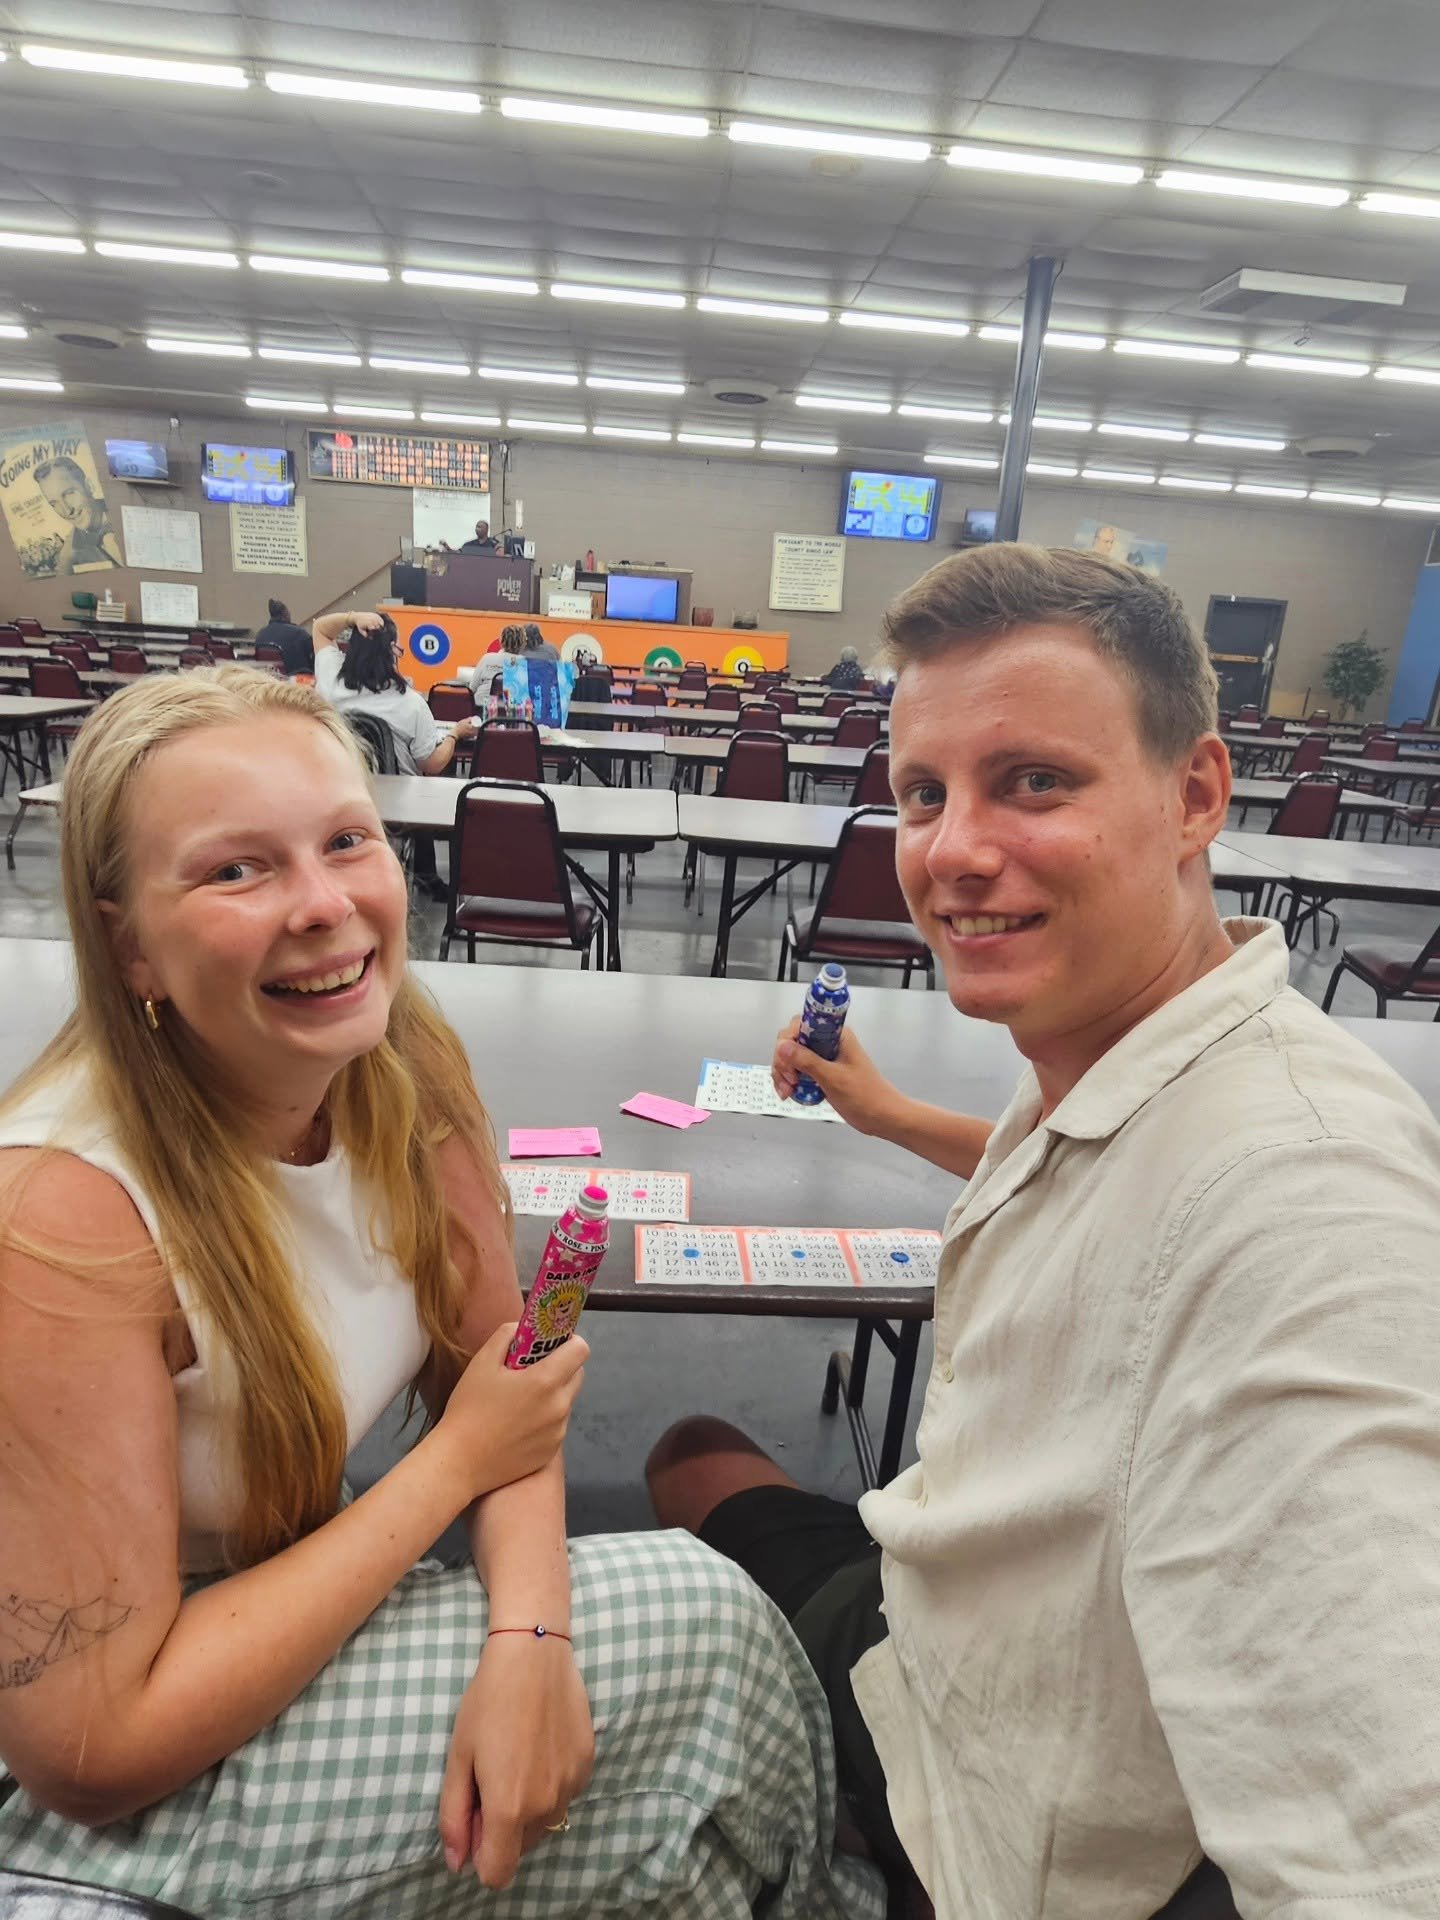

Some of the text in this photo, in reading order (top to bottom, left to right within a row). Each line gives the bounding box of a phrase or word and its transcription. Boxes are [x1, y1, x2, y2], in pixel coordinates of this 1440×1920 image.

[0, 438, 81, 488] GOING MY WAY
[497, 576, 521, 595] POWER
[424, 639, 435, 650] B
[737, 662, 748, 673] O
[646, 1229, 659, 1237] 10
[562, 1235, 606, 1252] ROSE PINK
[545, 1272, 570, 1280] DAB
[572, 1270, 581, 1278] O
[685, 1269, 701, 1277] 43
[530, 1332, 570, 1354] SUN
